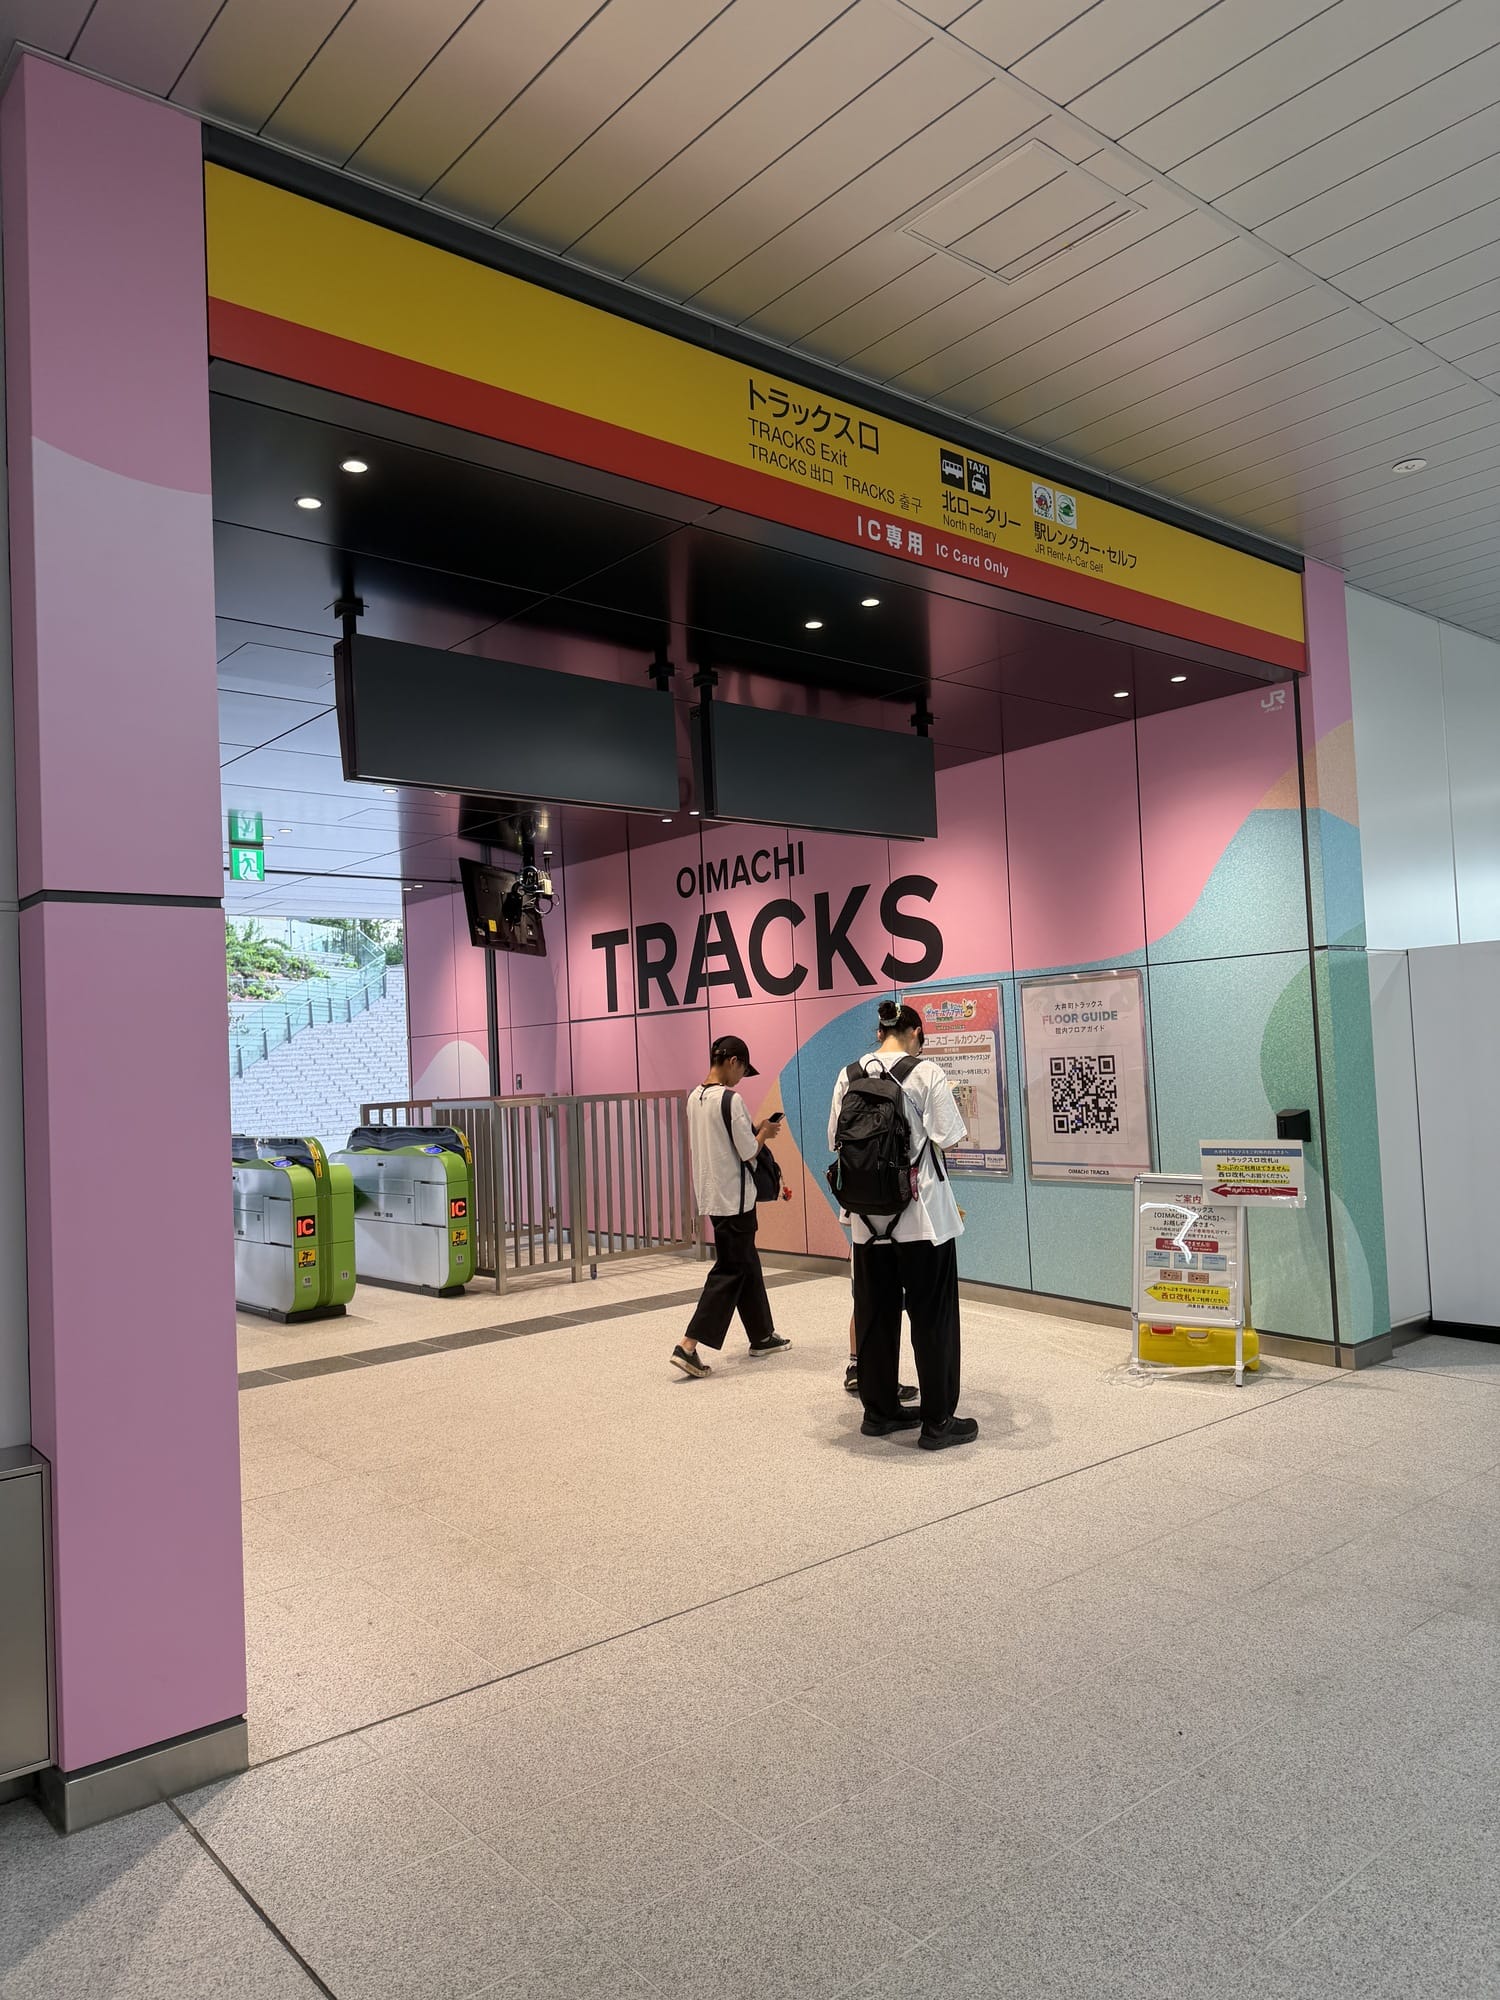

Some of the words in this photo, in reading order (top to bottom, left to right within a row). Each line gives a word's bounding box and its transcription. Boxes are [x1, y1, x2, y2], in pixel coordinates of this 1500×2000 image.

[749, 379, 880, 455] トラックス口
[748, 417, 816, 457] TRACKS
[821, 443, 848, 468] Exit
[748, 443, 807, 476] TRACKS
[810, 464, 834, 485] 出口
[968, 460, 988, 475] TAXI
[843, 475, 895, 505] TRACKS
[941, 490, 1021, 529] 北ロータリー
[857, 515, 923, 557] IC専用
[943, 514, 967, 532] North
[969, 522, 997, 543] Rotary
[1034, 520, 1137, 569] 駅レンタカー・セルフ
[936, 543, 949, 558] IC
[953, 548, 980, 567] Card
[984, 558, 1009, 578] Only
[1035, 543, 1045, 555] JR
[1047, 547, 1088, 568] Rent-A-Car
[1261, 690, 1285, 708] JR
[676, 841, 805, 898] OIMACHI
[592, 874, 944, 1013] TRACKS
[1042, 1013, 1079, 1025] FLOOR
[1081, 1010, 1118, 1023] GUIDE
[451, 1201, 466, 1217] IC
[1175, 1194, 1202, 1205] ご案内
[297, 1218, 314, 1236] IC
